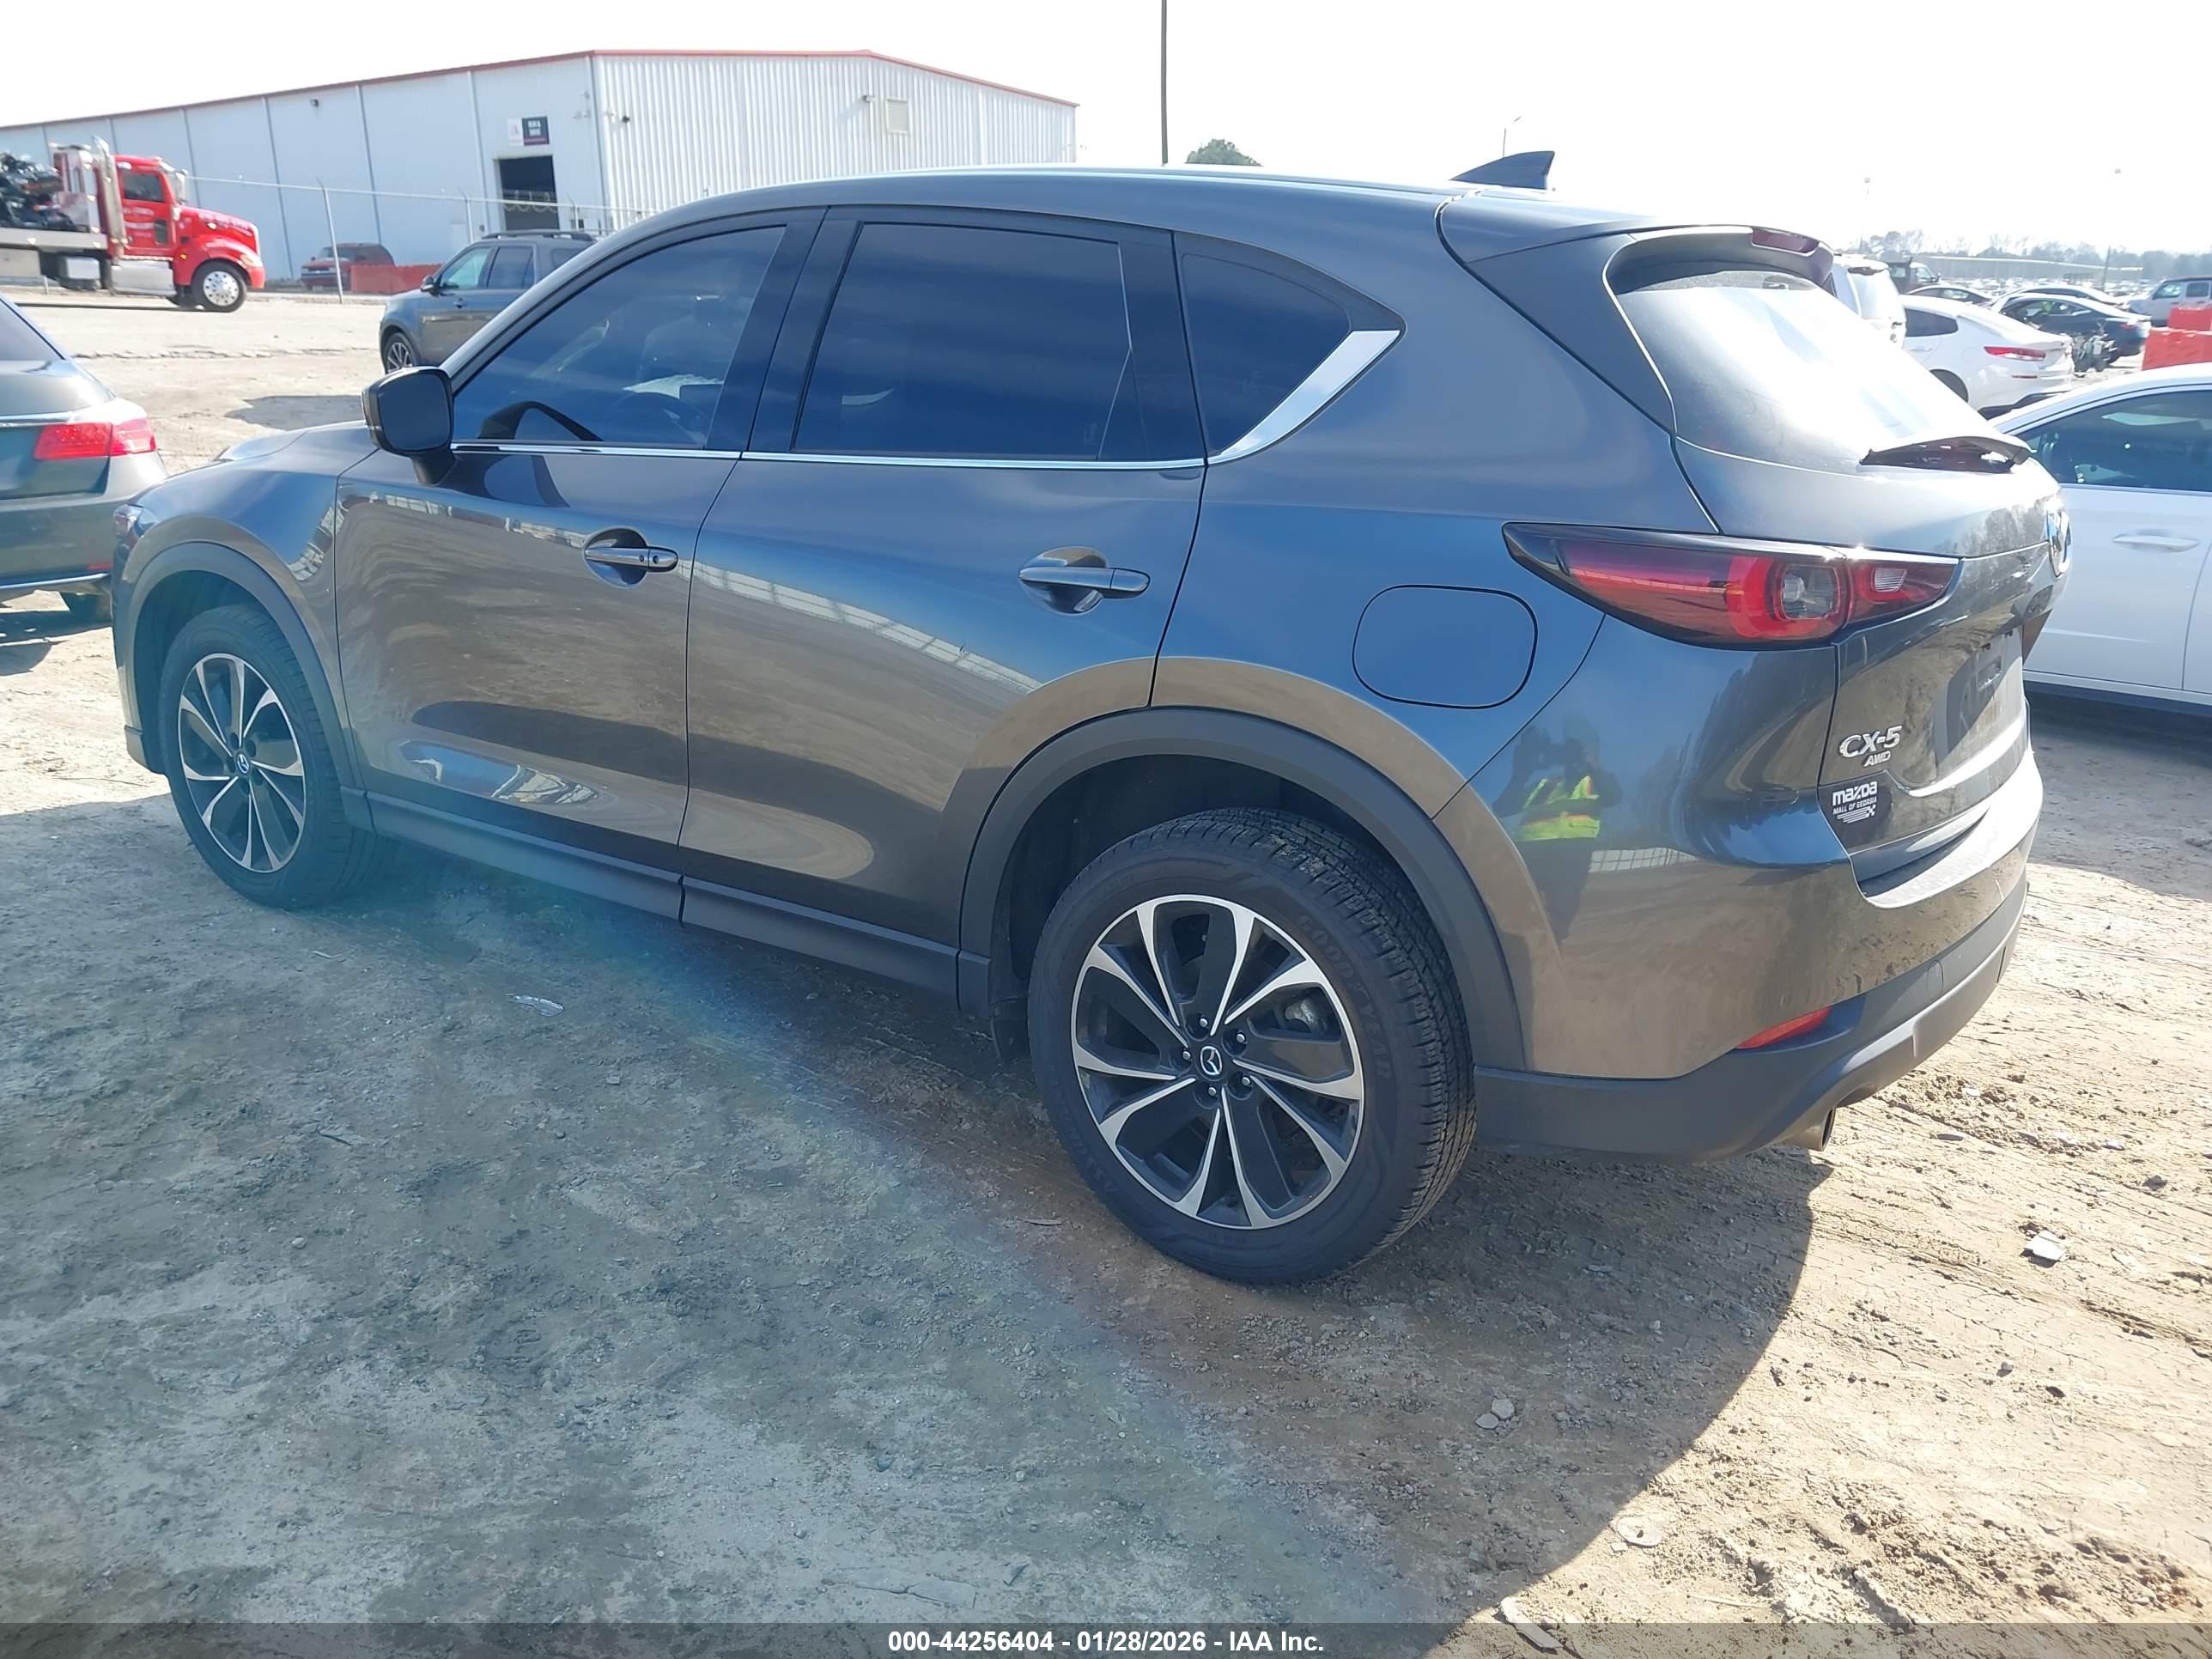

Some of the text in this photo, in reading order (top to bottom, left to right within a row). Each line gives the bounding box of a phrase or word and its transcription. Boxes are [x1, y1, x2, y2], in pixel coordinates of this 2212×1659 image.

[1838, 725, 1903, 758] CX-5
[1863, 750, 1891, 768] AWD
[1832, 796, 1878, 816] MALL OF GEORGIA
